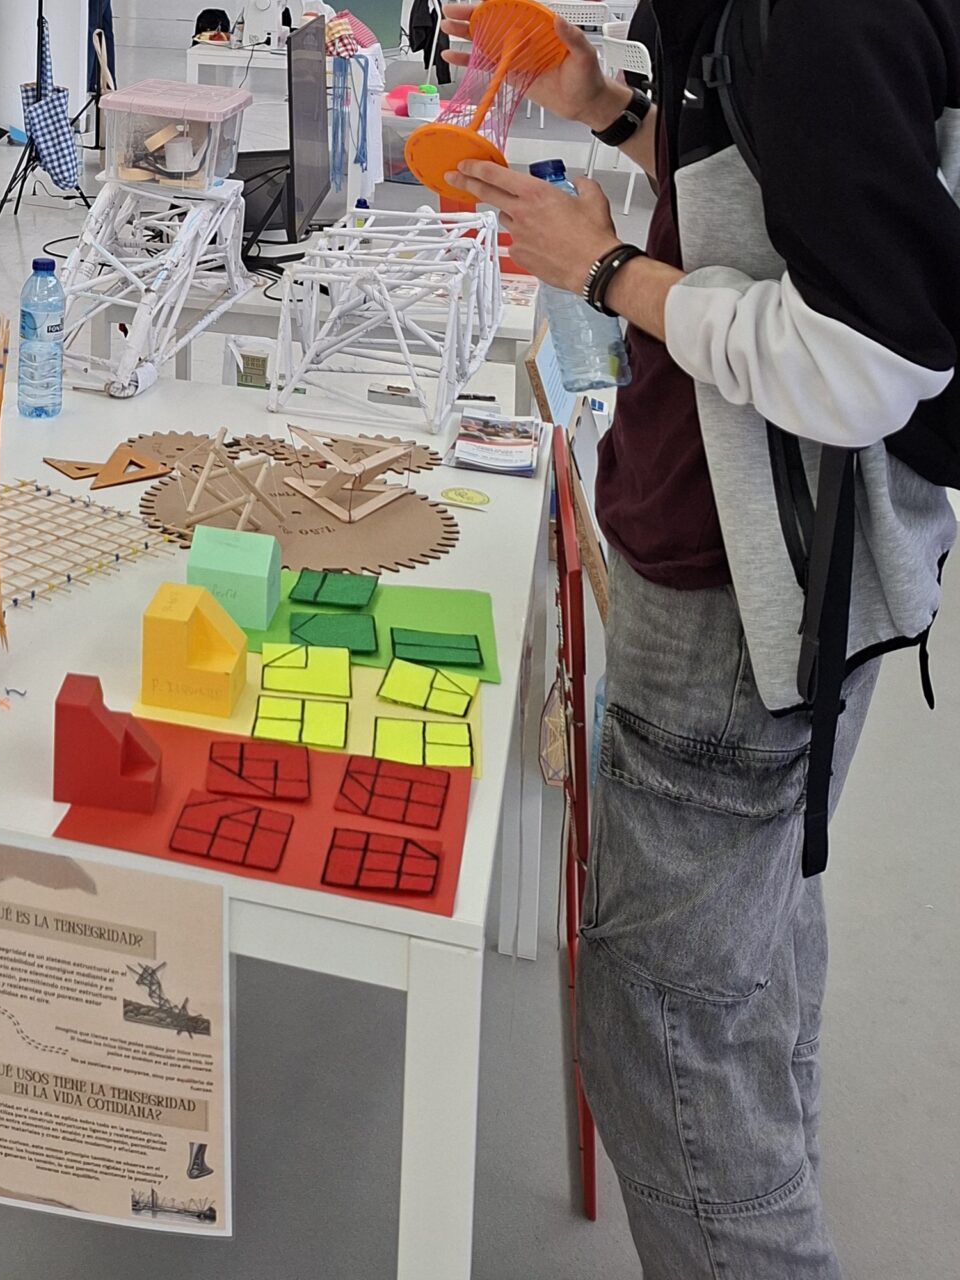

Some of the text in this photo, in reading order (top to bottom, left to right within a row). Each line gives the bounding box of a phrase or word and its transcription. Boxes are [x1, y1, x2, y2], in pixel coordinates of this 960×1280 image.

[16, 911, 30, 925] ES
[34, 914, 49, 929] LA
[54, 918, 144, 948] TENSEGRIDAD?
[14, 1081, 162, 1121] EN LA VIDA COTIDIANA?
[16, 1066, 49, 1086] USOS
[52, 1076, 87, 1093] TIENE
[90, 1082, 106, 1098] LA
[110, 1086, 196, 1112] TENSEGRIDAD
